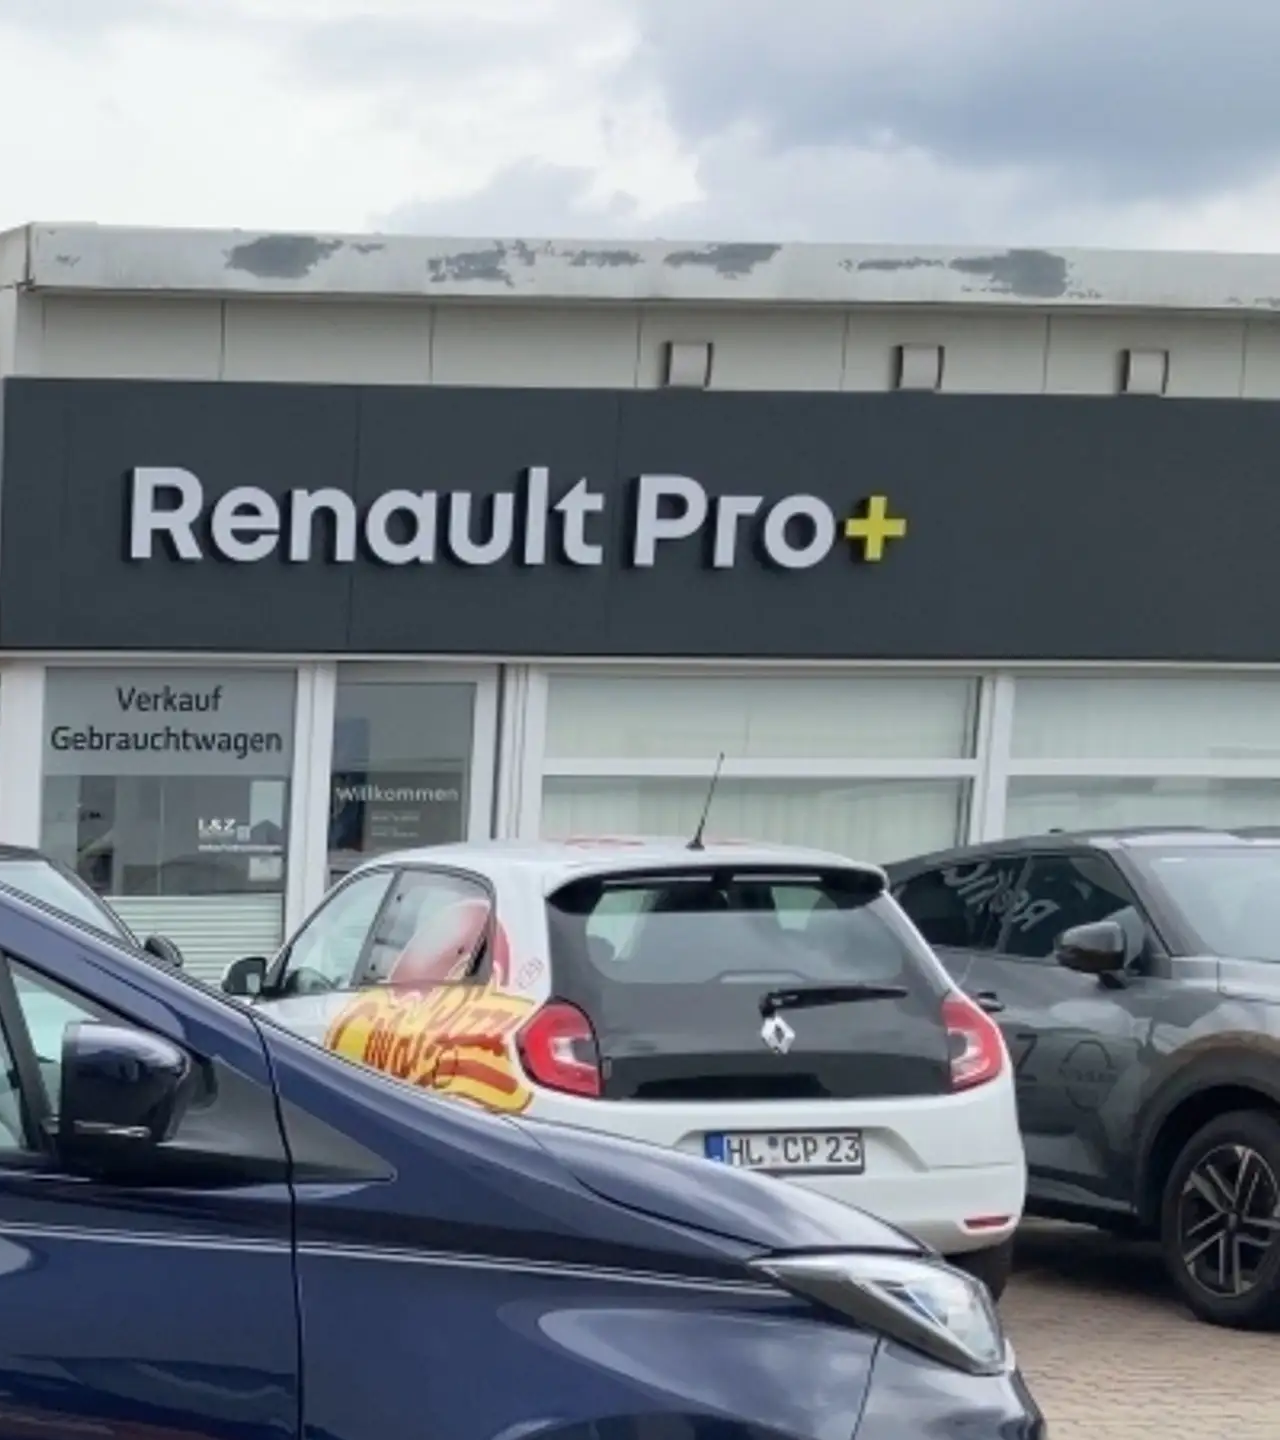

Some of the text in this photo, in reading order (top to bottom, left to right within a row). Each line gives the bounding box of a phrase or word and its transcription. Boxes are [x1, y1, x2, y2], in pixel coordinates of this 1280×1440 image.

[129, 467, 906, 569] Renault Pro+
[116, 685, 222, 713] Verkauf
[51, 725, 283, 759] Gebrauchtwagen
[336, 785, 458, 802] Willkommen
[726, 1136, 860, 1165] HL CP 23
